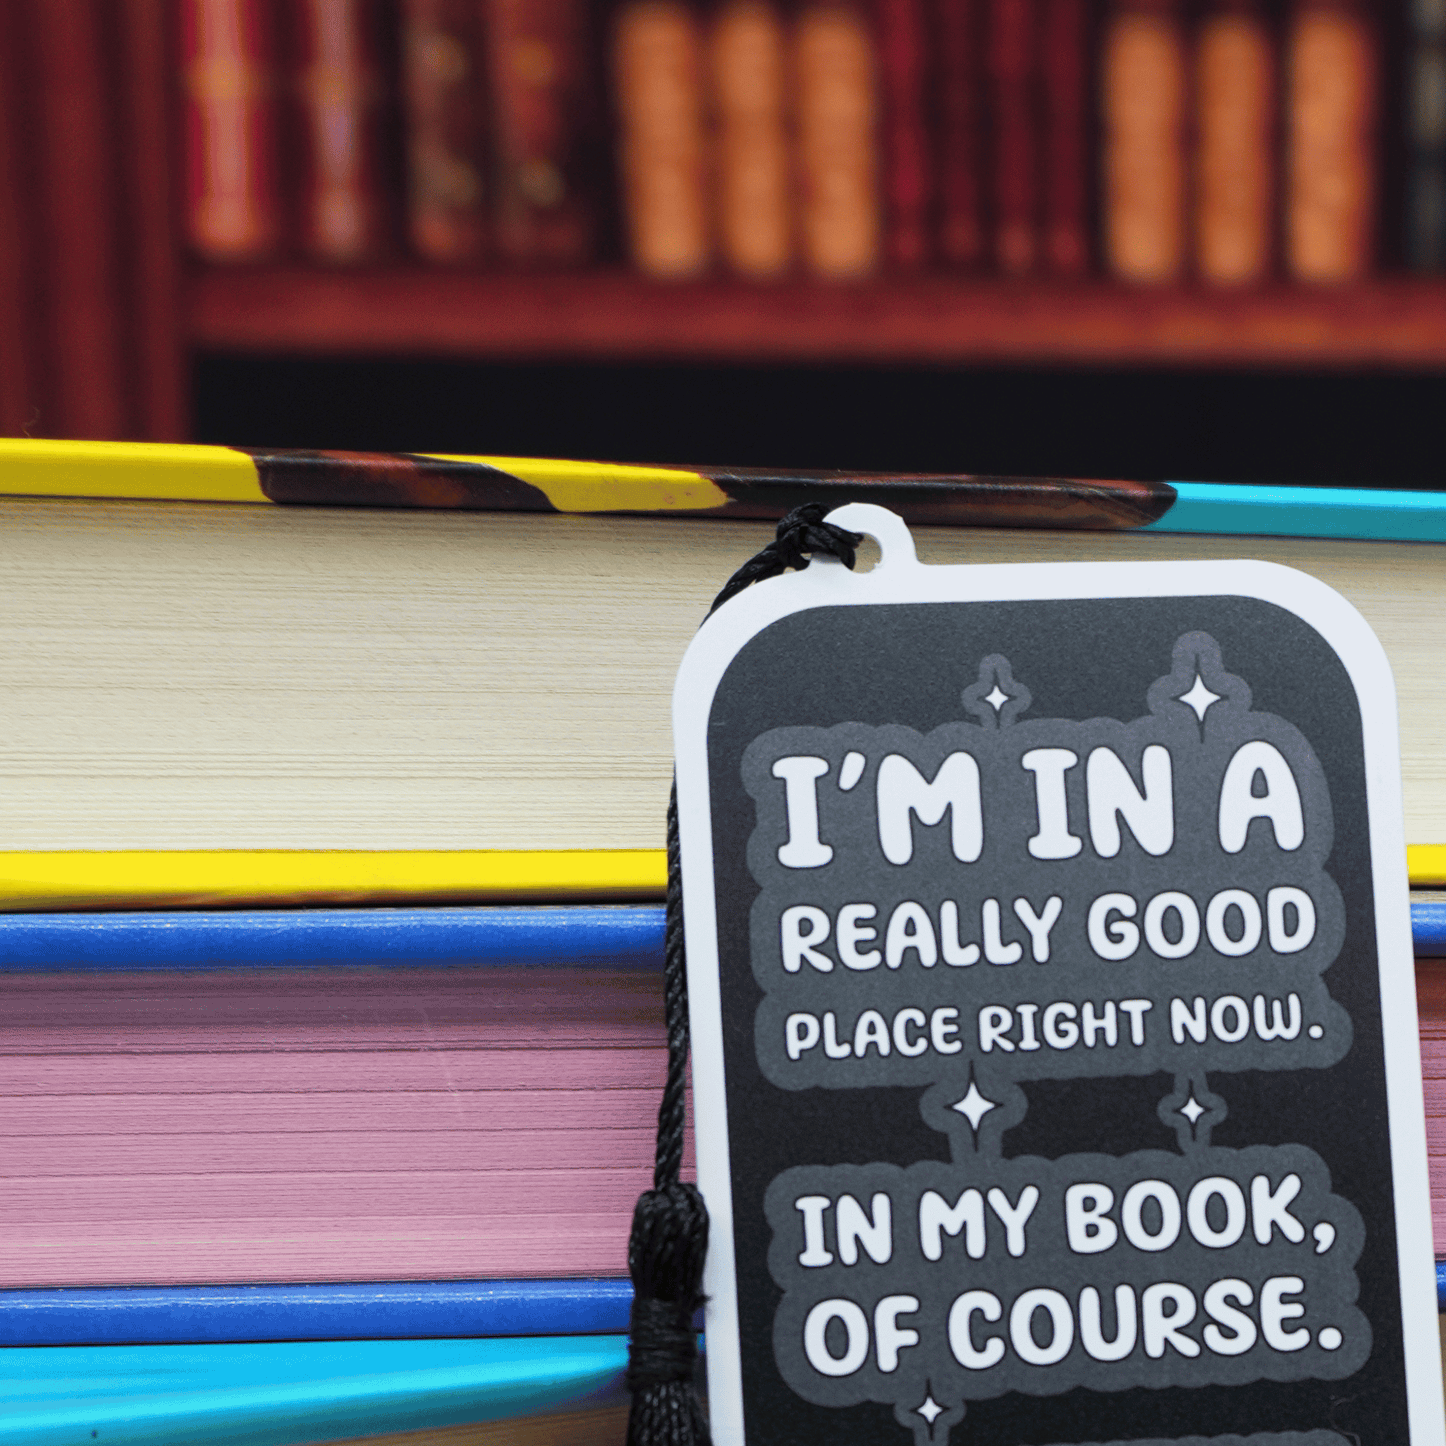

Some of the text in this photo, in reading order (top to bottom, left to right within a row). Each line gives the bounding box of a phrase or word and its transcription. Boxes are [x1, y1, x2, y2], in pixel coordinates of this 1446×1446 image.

[771, 740, 1305, 869] I'M IN A
[780, 886, 1317, 973] REALLY GOOD
[785, 993, 1324, 1060] PLACE RIGHT NOW.
[795, 1173, 1336, 1267] IN MY BOOK,
[803, 1276, 1343, 1377] OF COURSE.
